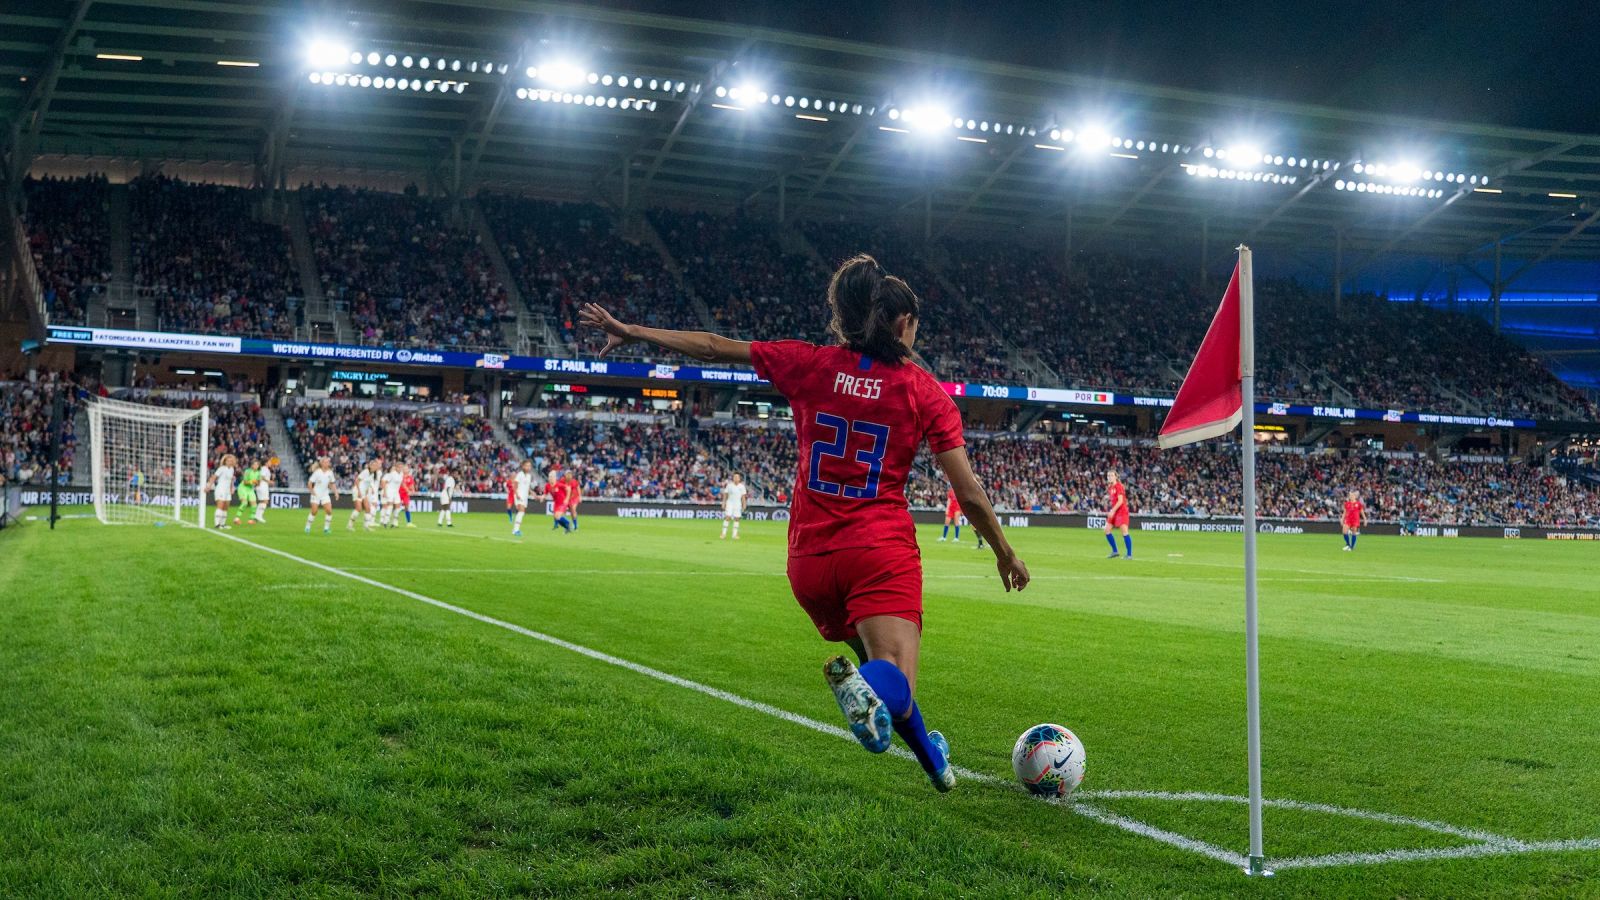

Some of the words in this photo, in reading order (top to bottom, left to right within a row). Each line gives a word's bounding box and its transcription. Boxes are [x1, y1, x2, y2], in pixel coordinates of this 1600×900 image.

[52, 330, 72, 338] FREE
[73, 332, 91, 340] WIFI
[273, 344, 309, 355] VICTORY
[312, 345, 334, 356] TOUR
[335, 347, 381, 359] PRESENTED
[383, 349, 393, 360] BY
[411, 352, 443, 362] Allstate
[544, 359, 560, 371] ST.
[562, 360, 589, 373] PAUL,
[591, 362, 608, 373] MN
[702, 370, 732, 380] VICTORY
[733, 372, 752, 381] TOUR
[834, 372, 882, 399] PRESS
[955, 384, 961, 395] 2
[982, 385, 1008, 398] 70:09
[1031, 390, 1037, 399] 0
[1075, 393, 1092, 401] POR
[1134, 397, 1158, 405] VICTORY
[1313, 407, 1325, 416] ST.
[1344, 409, 1355, 418] MN
[1418, 414, 1439, 423] VICTORY
[1454, 416, 1479, 424] PRESENTED
[808, 412, 890, 498] 23
[151, 495, 200, 506] Allsate
[617, 508, 664, 518] VICTORY
[666, 509, 695, 519] TOUR
[1009, 517, 1028, 527] MN
[1141, 522, 1176, 531] VICTORY
[1178, 523, 1200, 531] TOUR
[1443, 528, 1458, 537] MN
